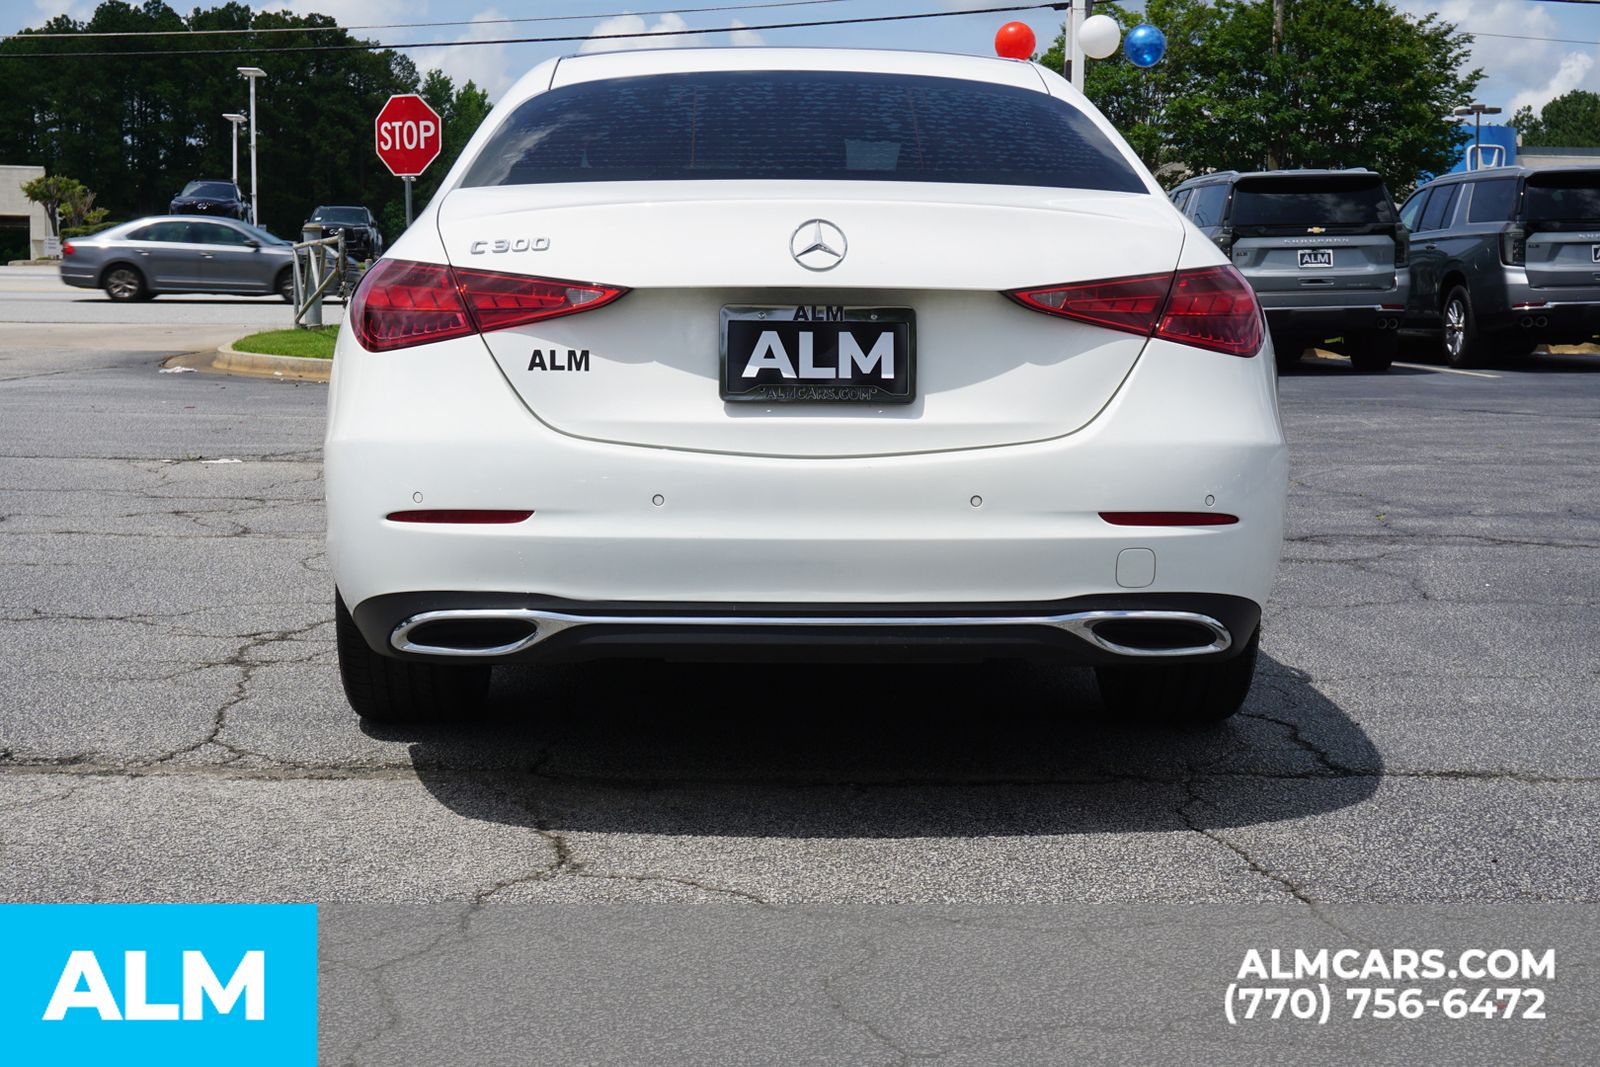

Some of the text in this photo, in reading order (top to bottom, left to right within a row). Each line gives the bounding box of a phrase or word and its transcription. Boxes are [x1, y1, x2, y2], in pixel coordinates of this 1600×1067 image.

[380, 120, 436, 151] STOP
[470, 237, 551, 255] C 300
[1302, 254, 1329, 263] ALM
[793, 306, 845, 322] ALM
[527, 350, 590, 372] ALM
[741, 331, 895, 379] ALM
